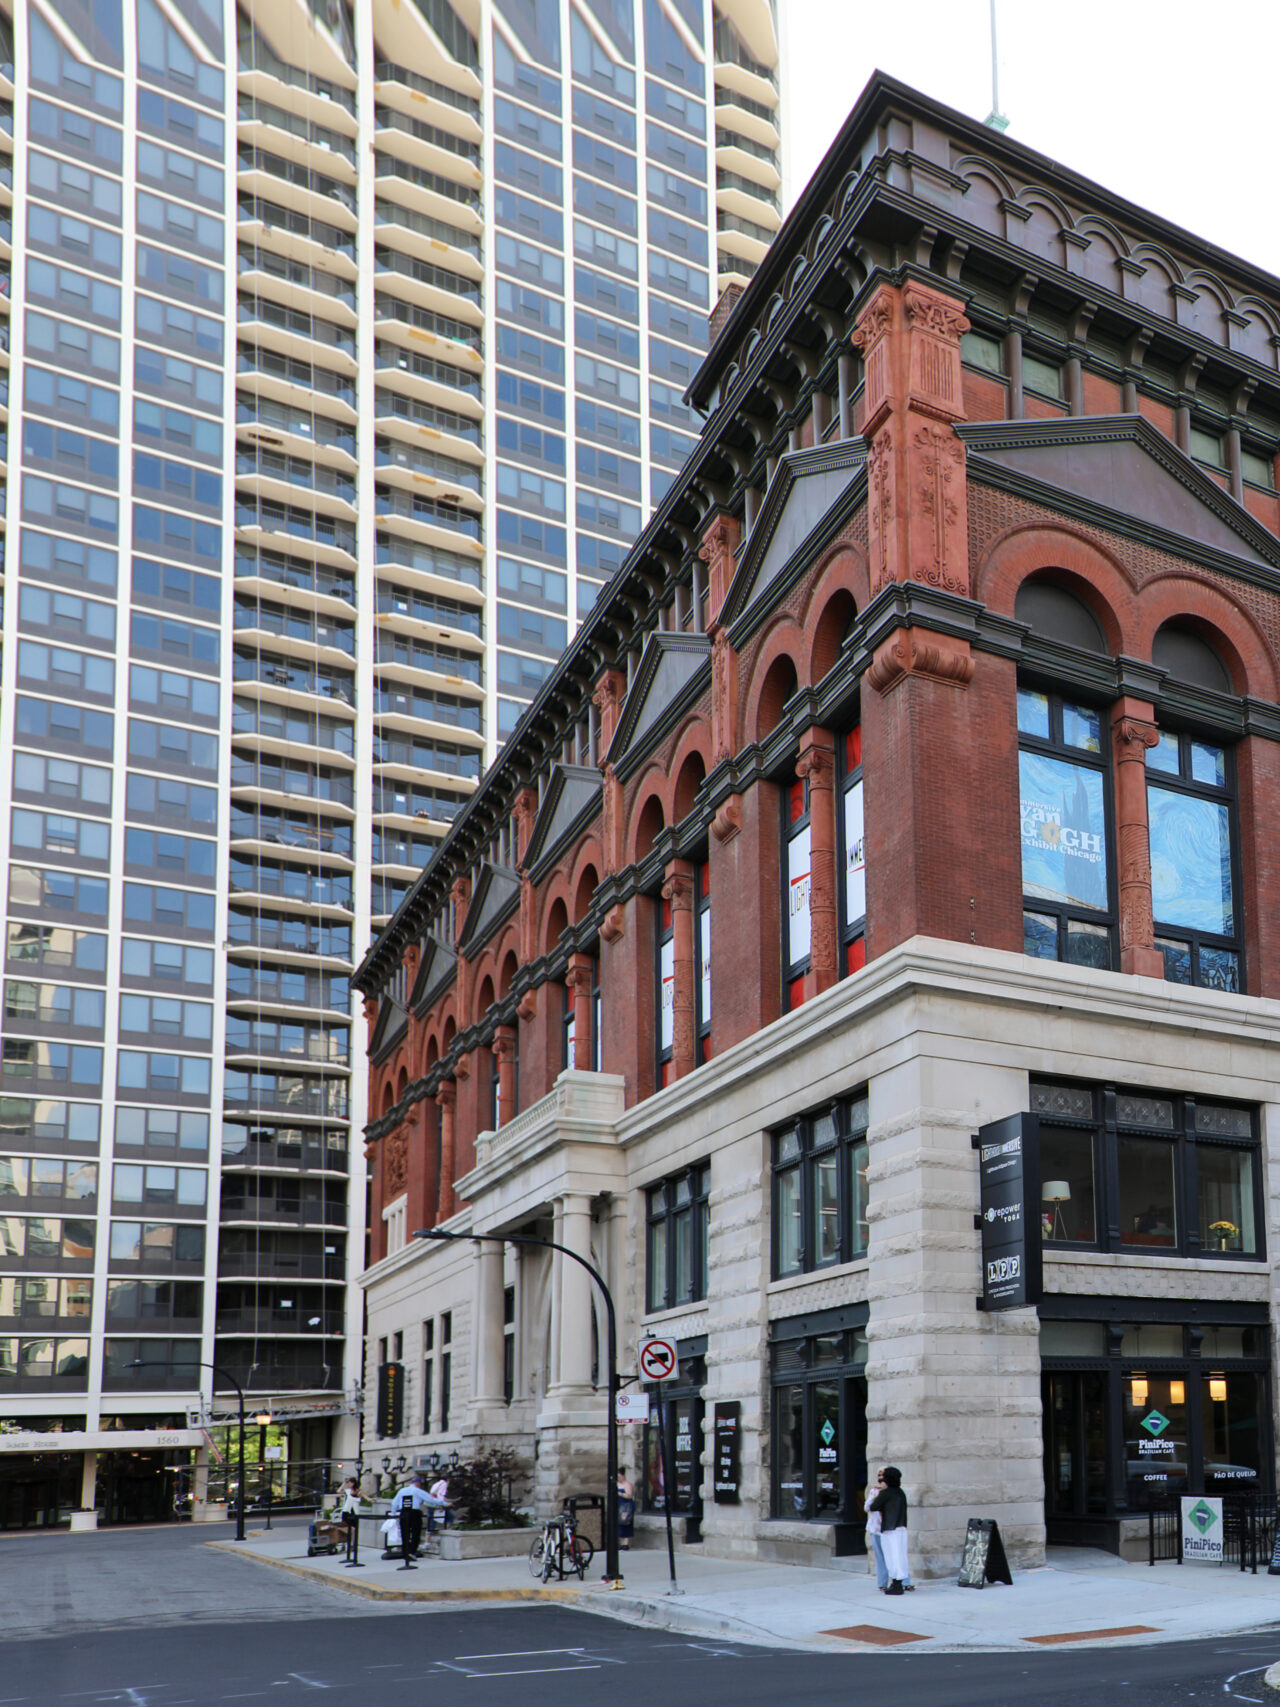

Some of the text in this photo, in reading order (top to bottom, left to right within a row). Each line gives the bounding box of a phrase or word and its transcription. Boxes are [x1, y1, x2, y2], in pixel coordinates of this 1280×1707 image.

[1020, 805, 1061, 826] van
[1060, 845, 1103, 863] Chicago
[984, 1202, 1021, 1222] corepower
[157, 1436, 179, 1445] 1560
[1139, 1438, 1174, 1449] PiniPico
[1184, 1537, 1221, 1551] PiniPico
